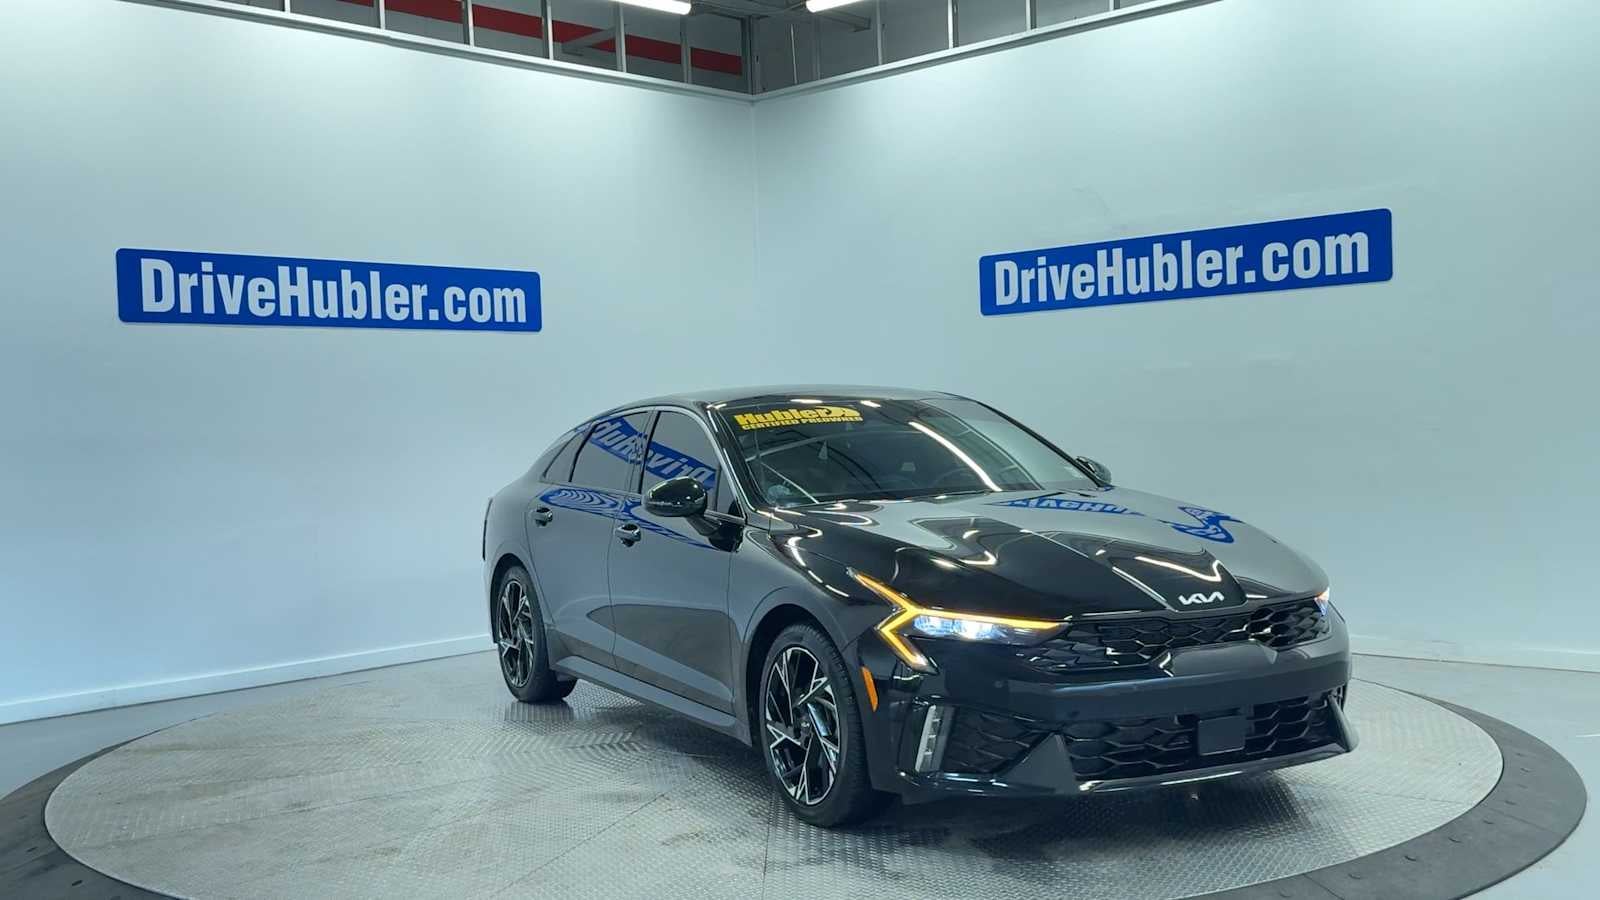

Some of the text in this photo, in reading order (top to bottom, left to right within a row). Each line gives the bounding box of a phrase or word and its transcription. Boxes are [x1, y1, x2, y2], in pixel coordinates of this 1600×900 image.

[994, 230, 1370, 306] DriveHubler.com
[140, 257, 527, 323] DriveHubler.com
[734, 408, 829, 425] Hubler
[742, 419, 800, 430] CERTIFIED
